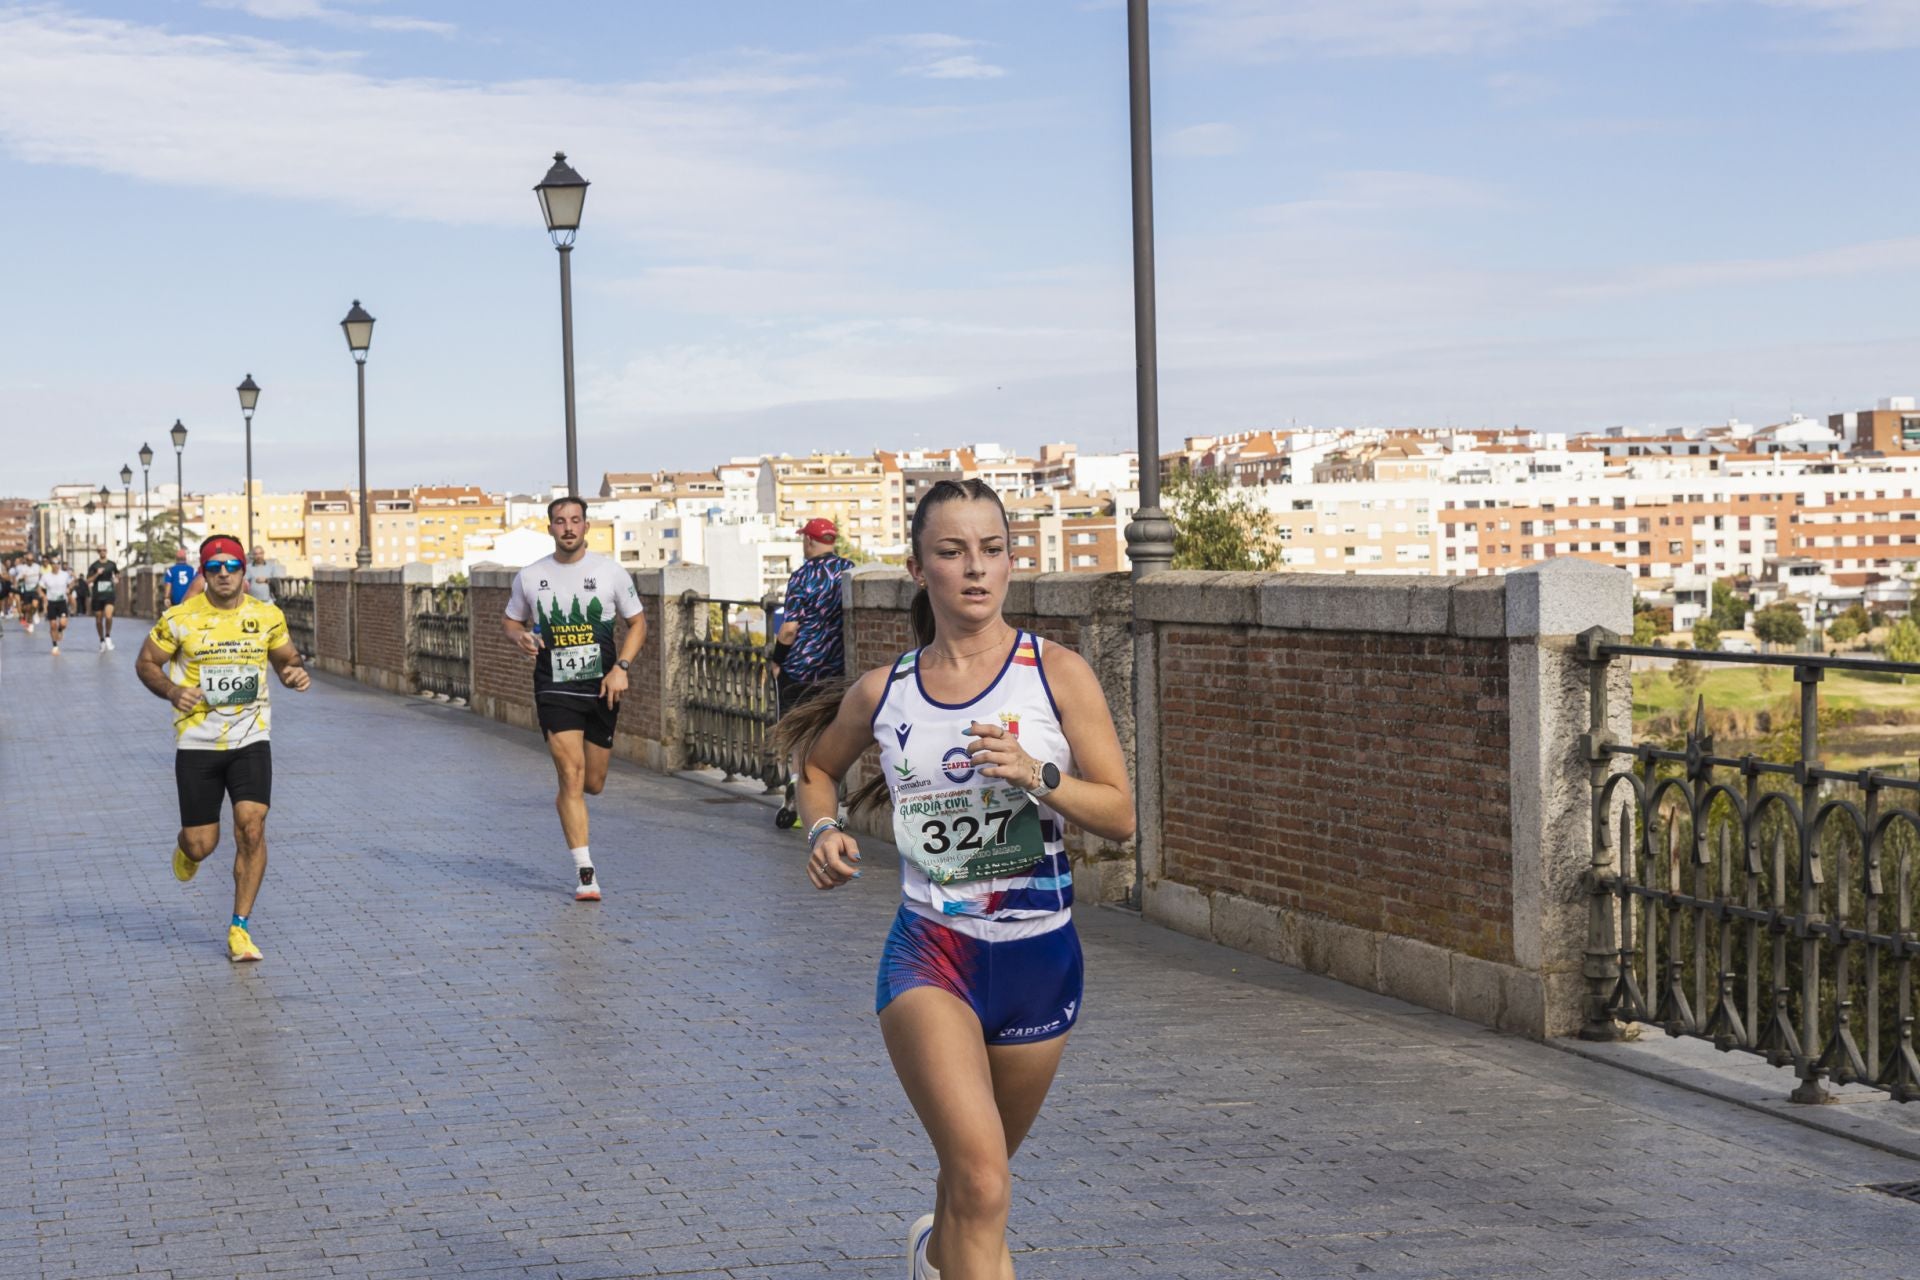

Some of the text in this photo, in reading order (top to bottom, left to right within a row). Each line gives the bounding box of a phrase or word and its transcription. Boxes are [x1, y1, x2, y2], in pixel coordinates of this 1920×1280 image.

[178, 570, 188, 585] 5
[553, 632, 594, 646] JEREZ
[556, 655, 598, 671] 1417
[206, 676, 256, 692] 1663
[947, 761, 970, 770] CAPEX
[900, 800, 941, 820] GUARDIA
[944, 797, 973, 809] CIVIL
[921, 809, 1013, 854] 327
[1006, 1023, 1052, 1036] CAPEX
